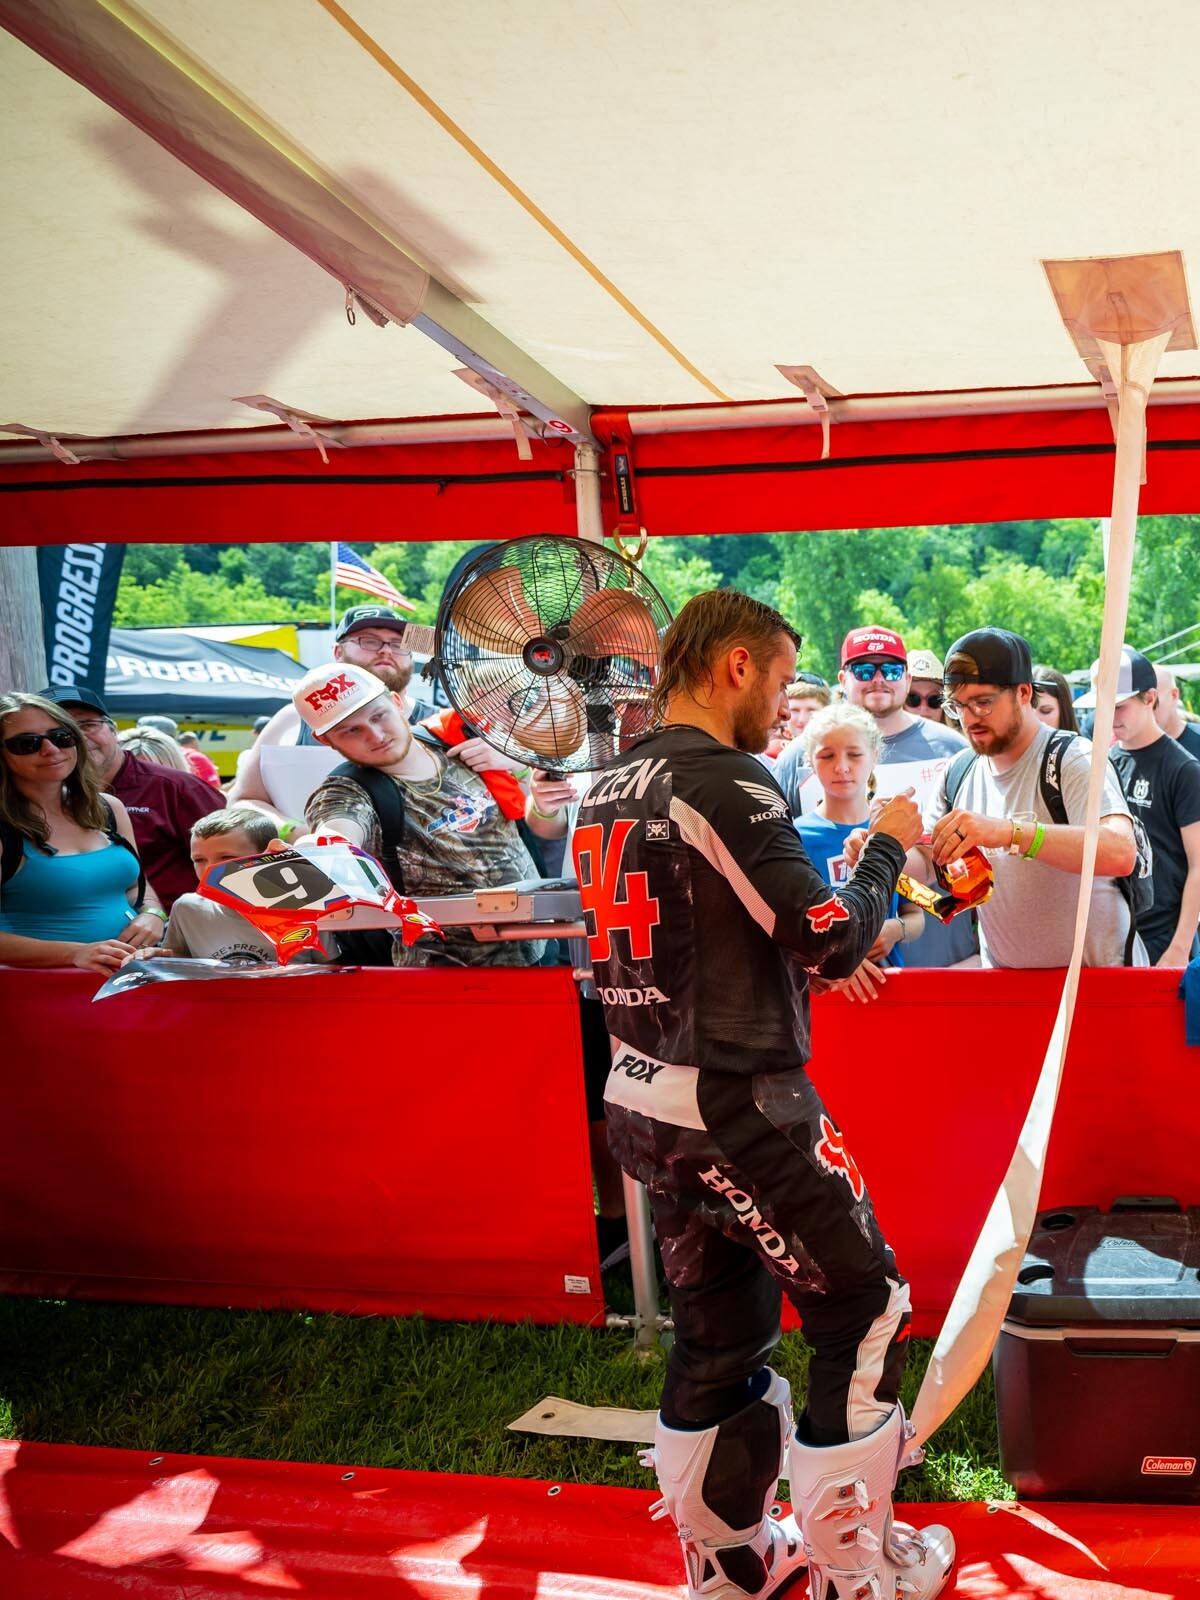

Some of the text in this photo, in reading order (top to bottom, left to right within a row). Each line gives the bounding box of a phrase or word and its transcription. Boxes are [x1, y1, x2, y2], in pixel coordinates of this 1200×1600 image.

[51, 543, 107, 687] PROGRESS
[853, 633, 897, 645] HONDA
[572, 819, 661, 963] 94
[613, 1054, 666, 1085] FOX
[697, 1164, 800, 1275] HONDA
[1145, 1459, 1184, 1470] Coleman
